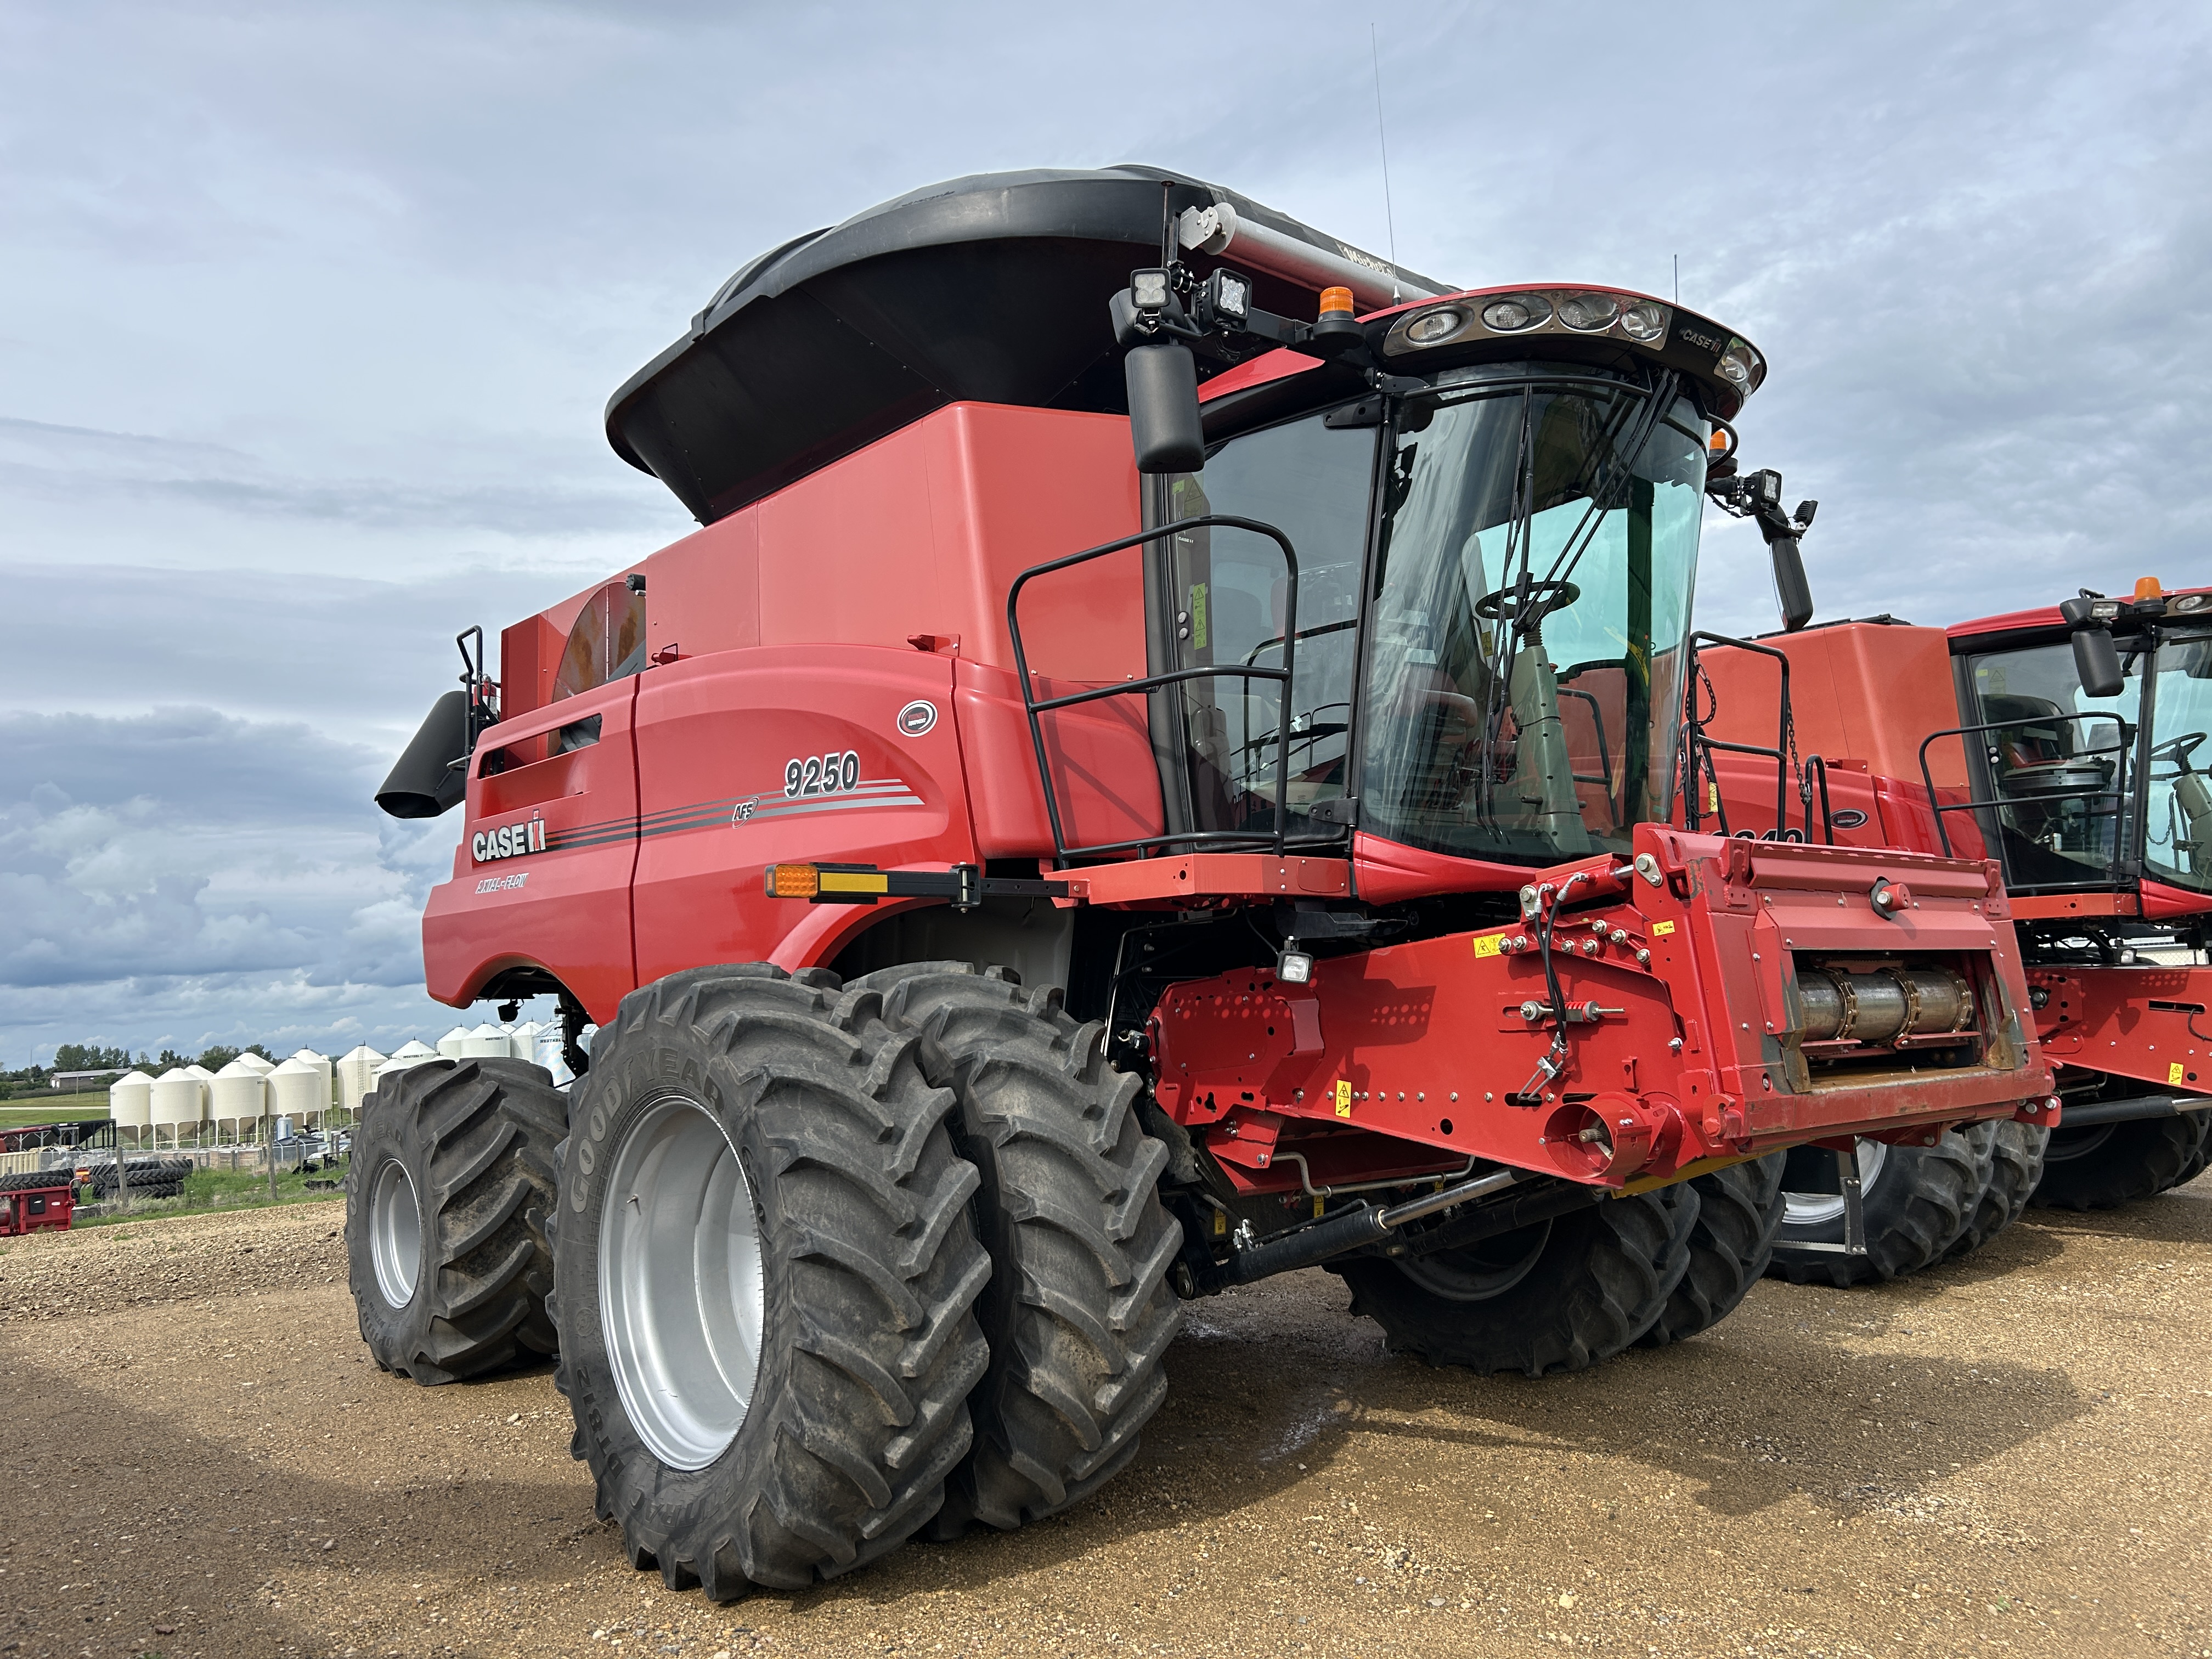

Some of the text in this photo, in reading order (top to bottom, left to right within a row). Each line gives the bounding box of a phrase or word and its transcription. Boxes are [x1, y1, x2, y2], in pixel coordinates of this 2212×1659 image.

[1683, 329, 1712, 349] CASE
[783, 749, 860, 799] 9250
[731, 801, 755, 822] AFS
[472, 823, 526, 862] CASE
[475, 872, 530, 894] AXIAL-FLOW
[571, 1047, 725, 1213] GOODYEAR
[577, 1365, 626, 1480] DT812
